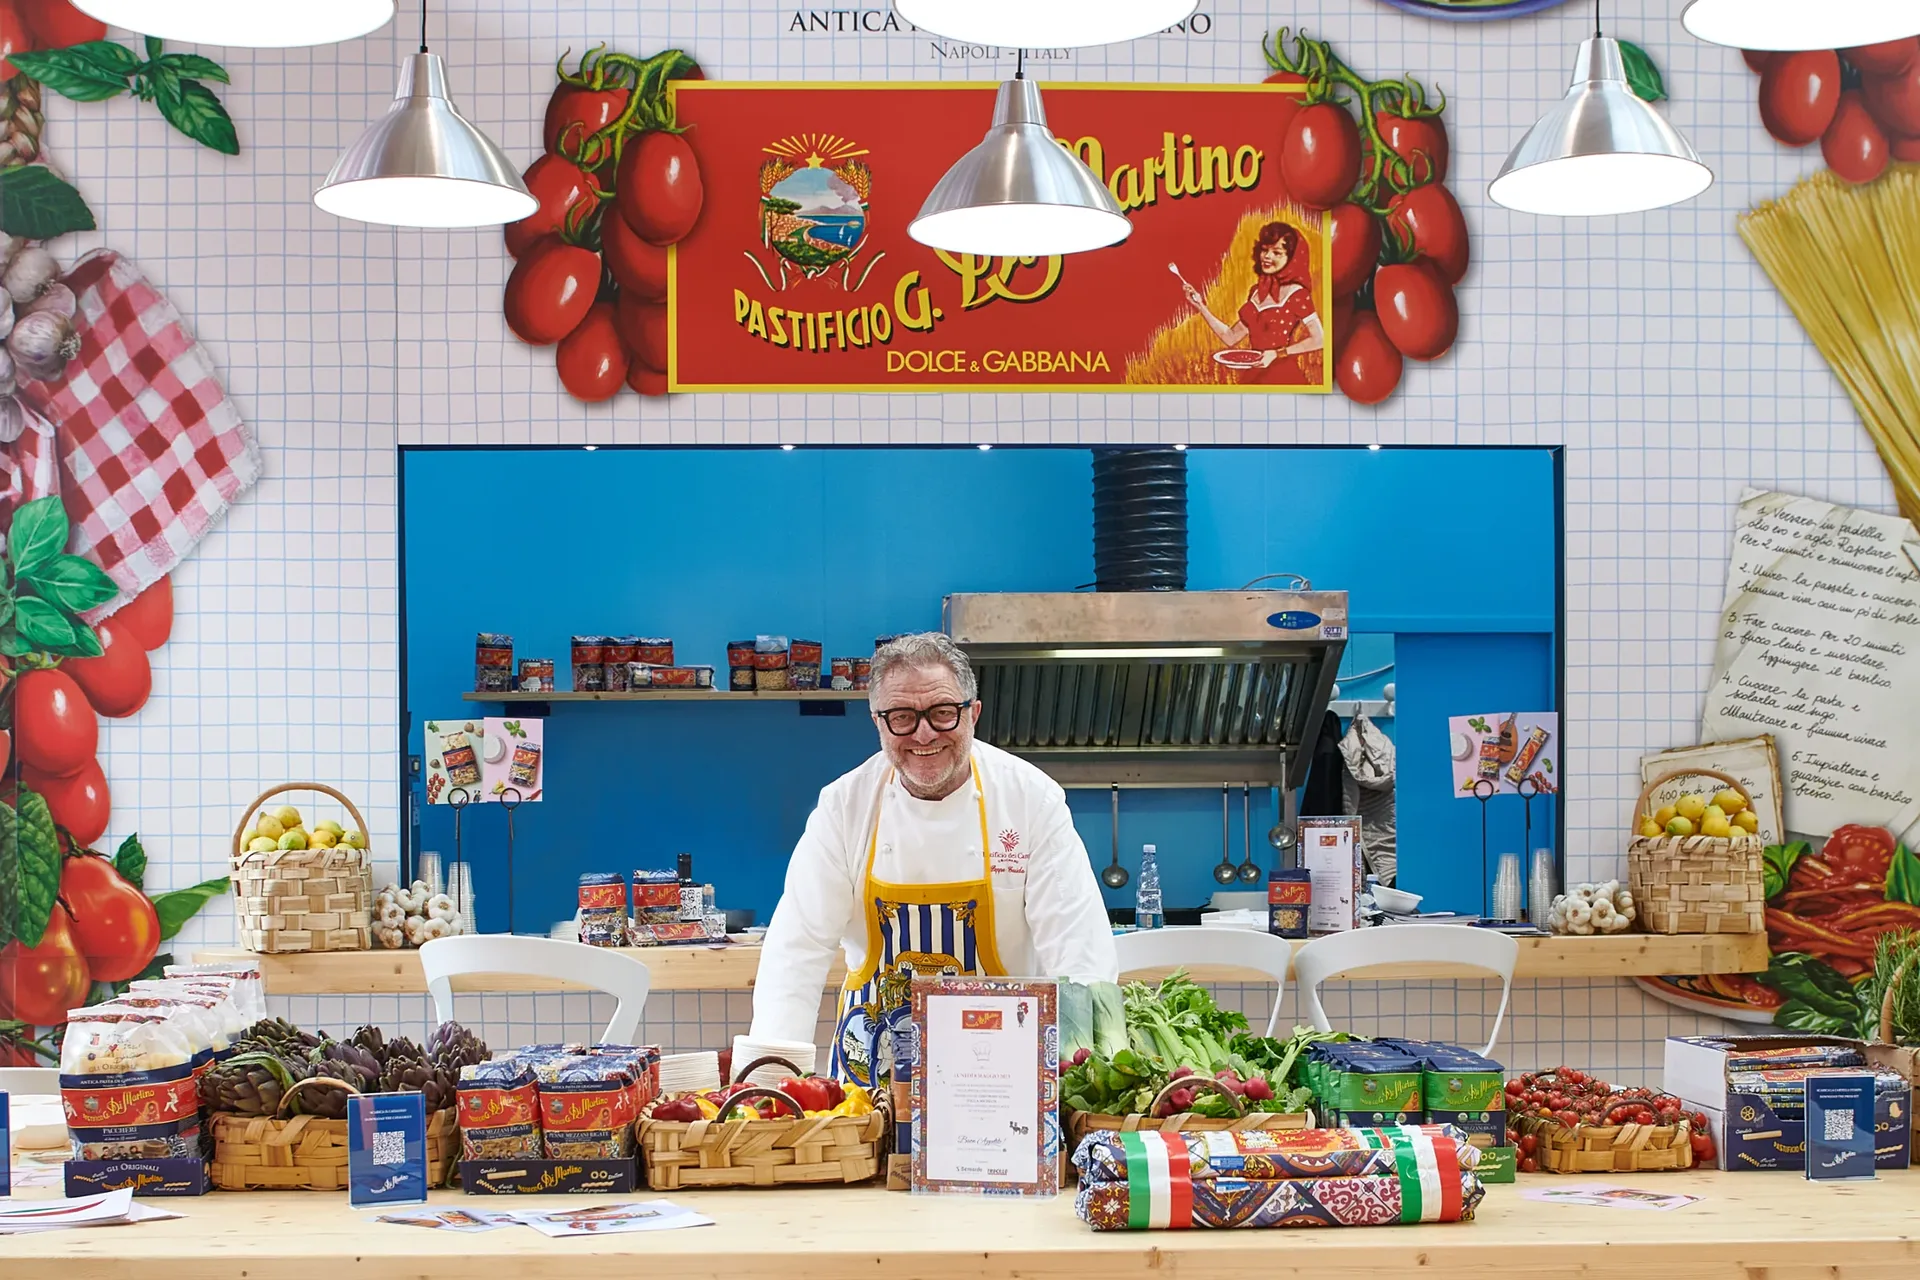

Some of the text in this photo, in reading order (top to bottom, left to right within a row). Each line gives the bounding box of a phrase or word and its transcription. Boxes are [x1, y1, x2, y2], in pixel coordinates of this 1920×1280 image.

[788, 11, 901, 33] ANTICA
[734, 288, 893, 351] PASTIFICIO
[893, 270, 944, 333] G.
[887, 351, 966, 373] DOLCE
[983, 350, 1111, 373] GABBANA
[1748, 519, 1770, 532] olio
[1793, 531, 1802, 539] e
[1774, 508, 1817, 526] Versare
[1819, 519, 1835, 530] in
[1837, 524, 1886, 541] padella
[1761, 538, 1773, 549] 2
[1772, 546, 1814, 559] minuti
[1828, 556, 1884, 575] rimuovere
[1753, 564, 1788, 580] Unire
[1792, 572, 1812, 587] la
[1811, 580, 1858, 597] passata
[1872, 593, 1917, 607] cuocere
[1738, 580, 1789, 600] fiamma
[1791, 592, 1816, 606] viva
[1817, 600, 1838, 611] con
[1871, 608, 1887, 620] di
[1888, 612, 1920, 625] sale
[1724, 631, 1737, 640] a
[1740, 630, 1771, 645] fuoco
[1772, 637, 1806, 652] lento
[1824, 651, 1888, 671] mescolare.
[1743, 613, 1767, 628] Far
[1771, 622, 1816, 637] cuocere
[1820, 630, 1840, 642] per
[1843, 634, 1862, 646] 20
[1861, 641, 1906, 655] minuti
[1758, 649, 1892, 688] Aggiungere il basilico.
[1722, 671, 1861, 712] 4. Cuocere la pasta e
[1725, 689, 1838, 724] scolarla nel sugo.
[1719, 704, 1788, 729] Mantecare
[1790, 722, 1802, 730] a
[1806, 722, 1853, 742] fiamma
[1803, 753, 1868, 777] Impiattare
[1871, 773, 1880, 782] e
[1659, 789, 1678, 802] 400
[1791, 770, 1913, 804] guarnire con basilico
[1792, 783, 1834, 801] fresco.
[120, 1090, 155, 1113] Martino
[578, 1097, 609, 1118] Martino
[106, 1163, 160, 1173] GLI ORIGINALI
[550, 1165, 583, 1186] Martino
